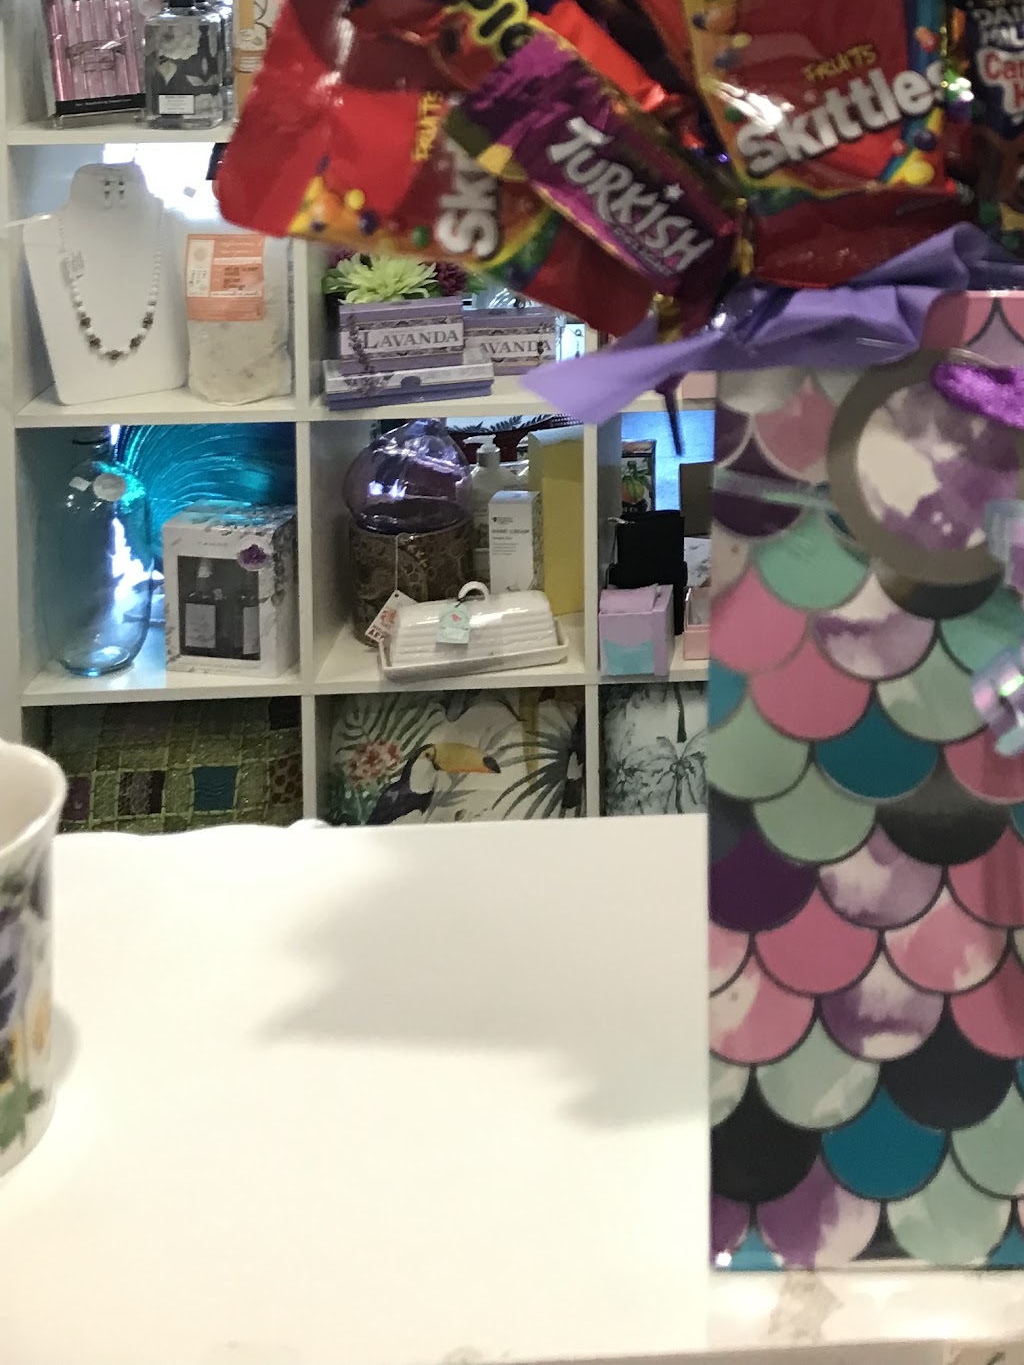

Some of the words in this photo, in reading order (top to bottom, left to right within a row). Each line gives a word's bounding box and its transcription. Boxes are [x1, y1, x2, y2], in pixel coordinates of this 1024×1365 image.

[803, 44, 877, 82] FRUITS
[548, 116, 714, 272] TURKISH
[364, 329, 460, 350] LAVANDA
